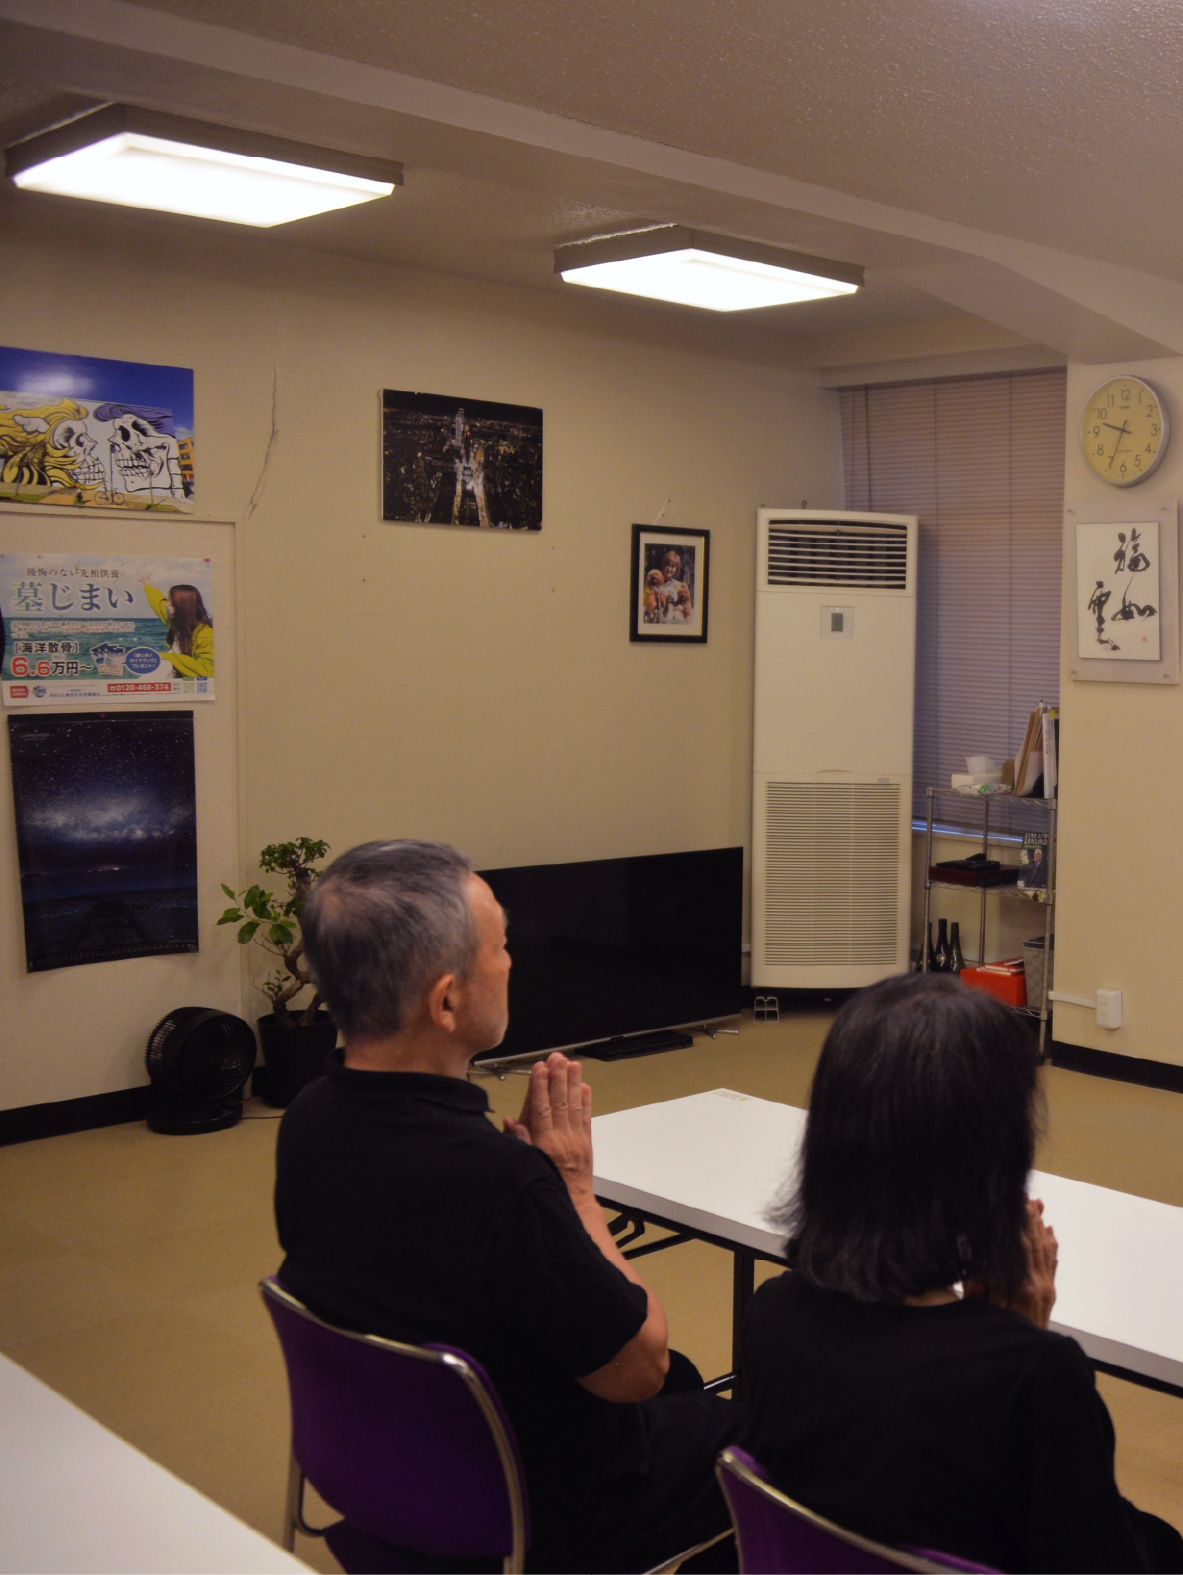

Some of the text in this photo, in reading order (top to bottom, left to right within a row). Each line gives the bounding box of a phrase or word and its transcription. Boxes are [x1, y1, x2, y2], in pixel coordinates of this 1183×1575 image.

[1107, 394, 1114, 406] 11
[1121, 389, 1131, 400] 12
[1097, 408, 1107, 419] 10
[1146, 405, 1153, 417] 2
[1093, 426, 1100, 438] 9
[1151, 424, 1157, 436] 3
[1097, 444, 1104, 455] 8
[1145, 443, 1151, 454] 4
[1120, 461, 1126, 472] 6
[1134, 455, 1141, 467] 5
[27, 567, 120, 578] 後悔のない先祖供養
[12, 582, 134, 611] 墓じまい
